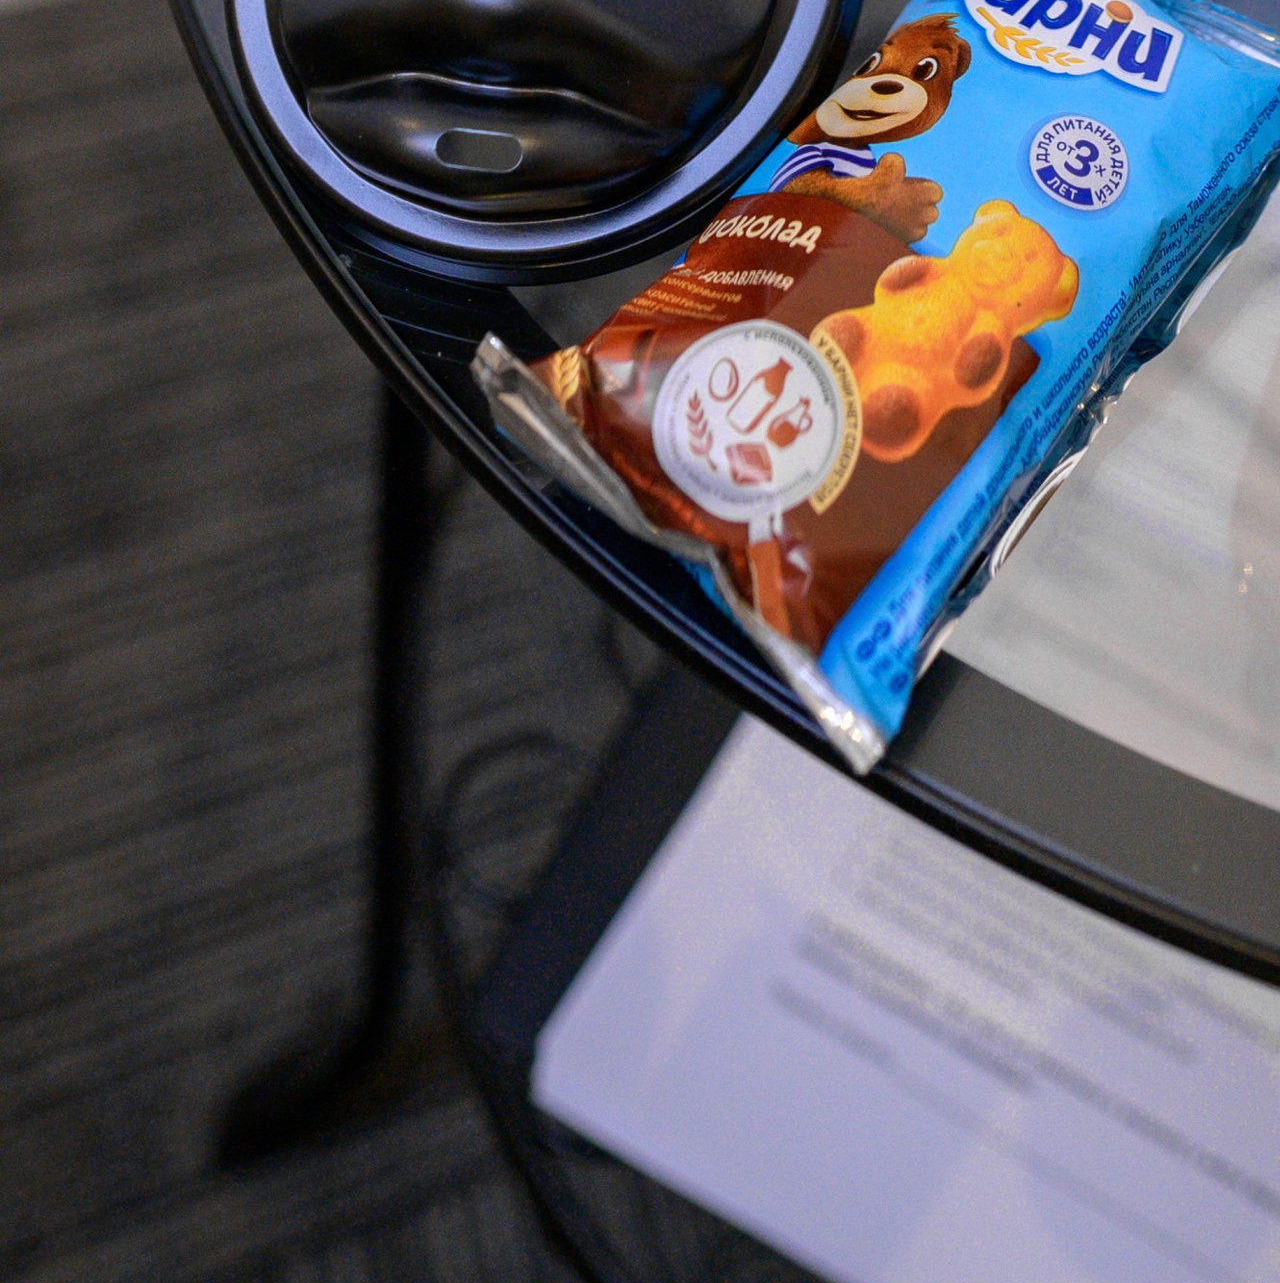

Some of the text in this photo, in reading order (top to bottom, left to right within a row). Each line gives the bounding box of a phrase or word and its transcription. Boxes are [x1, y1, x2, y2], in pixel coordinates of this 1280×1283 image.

[1036, 119, 1124, 205] ДЛЯ ПИТАНИЯ ДЕТЕЙ
[1047, 177, 1078, 200] ЛЕТ
[698, 269, 794, 292] ДОБАВЛЕНИЯ
[1033, 409, 1042, 421] и
[1041, 348, 1090, 412] школьного
[1169, 214, 1188, 237] для
[1186, 151, 1237, 216] Таможенного
[1234, 122, 1259, 156] союза
[1256, 98, 1280, 129] стран
